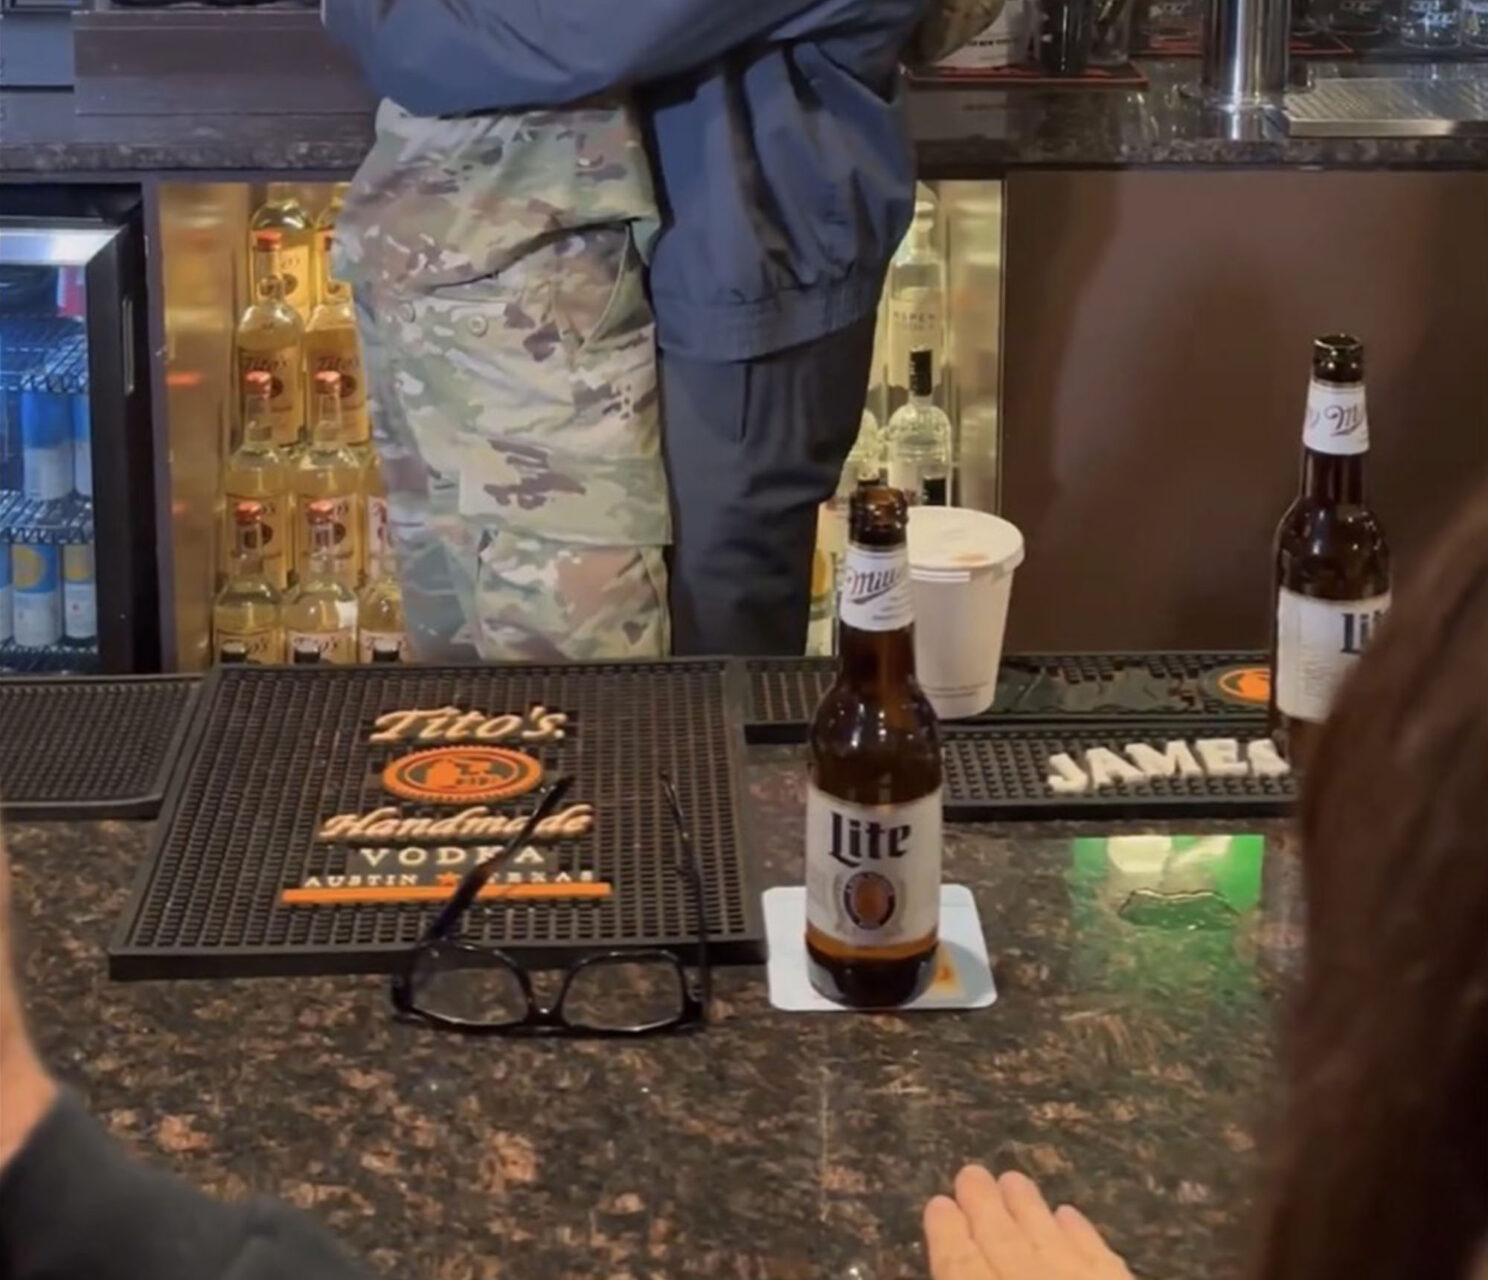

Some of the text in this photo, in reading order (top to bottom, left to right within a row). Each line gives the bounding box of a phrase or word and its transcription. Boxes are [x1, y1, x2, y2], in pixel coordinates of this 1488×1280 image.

[369, 705, 568, 742] Tito's
[1047, 737, 1291, 793] JAMES
[317, 803, 596, 842] Handmade
[829, 811, 911, 868] Lite
[360, 846, 545, 867] VODKA
[303, 874, 419, 887] AUSTIN
